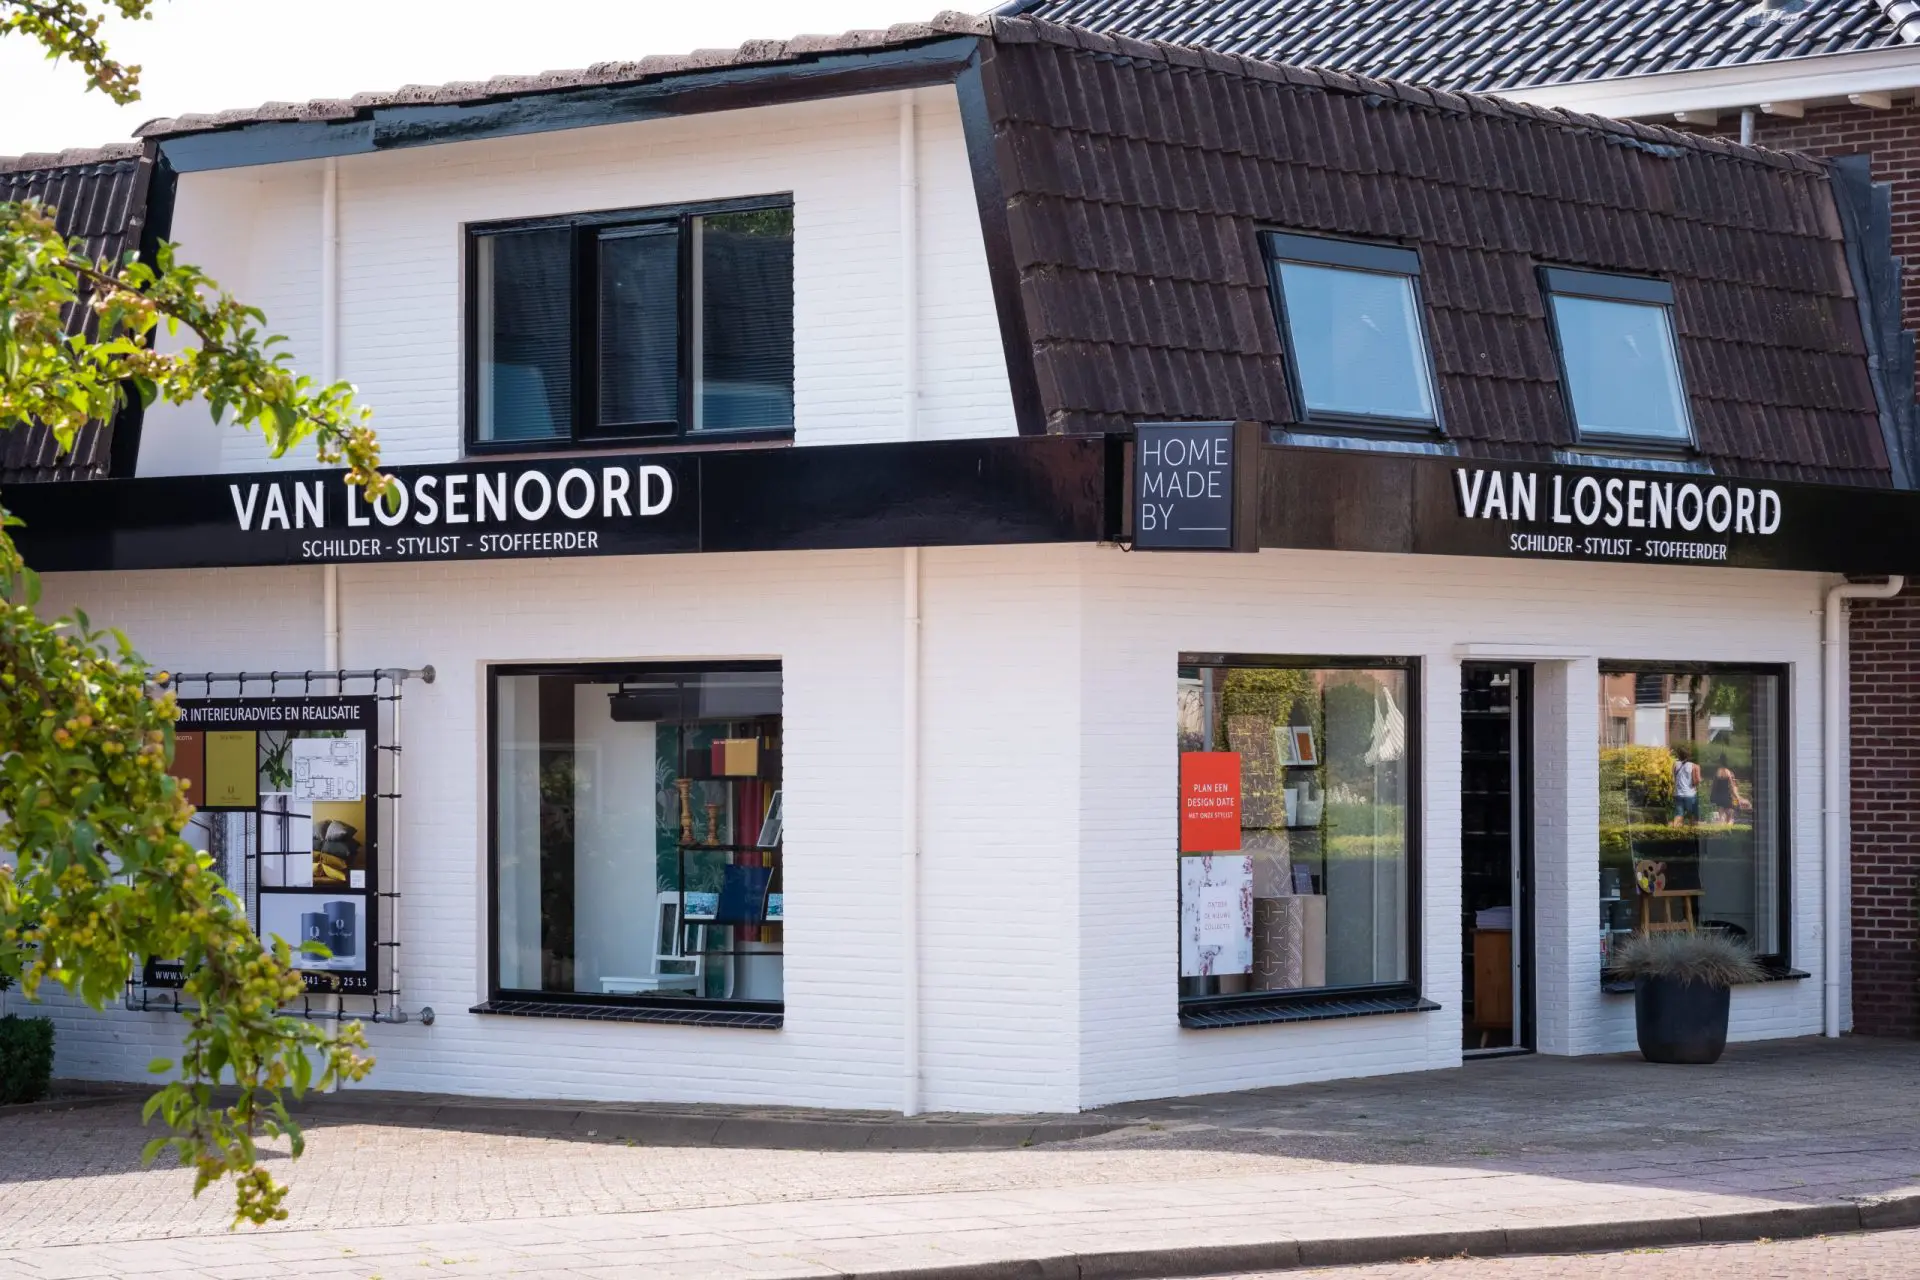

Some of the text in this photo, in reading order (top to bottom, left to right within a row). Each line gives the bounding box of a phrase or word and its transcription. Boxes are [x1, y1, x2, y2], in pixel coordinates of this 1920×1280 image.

[1143, 438, 1228, 466] HOME
[229, 465, 673, 531] VAN LOSENOORD
[1142, 471, 1222, 498] MADE
[1457, 468, 1781, 535] VAN LOSENOORD
[1142, 503, 1174, 530] BY
[302, 538, 381, 558] SCHILDER
[397, 536, 460, 555] STYLIST
[480, 531, 599, 552] STOFFEERDER
[1510, 533, 1573, 553] SCHILDER
[1584, 537, 1632, 555] STYLIST
[1645, 540, 1727, 560] STOFFEERDER
[190, 706, 282, 721] INTERIEURADVIES
[284, 706, 299, 720] EN
[302, 705, 360, 720] REALISATIE
[1193, 783, 1228, 793] PLAN EEN
[1187, 797, 1235, 807] DESIGN DATE
[1215, 811, 1233, 819] STYLIST
[343, 977, 354, 986] 25
[357, 977, 367, 987] 15
